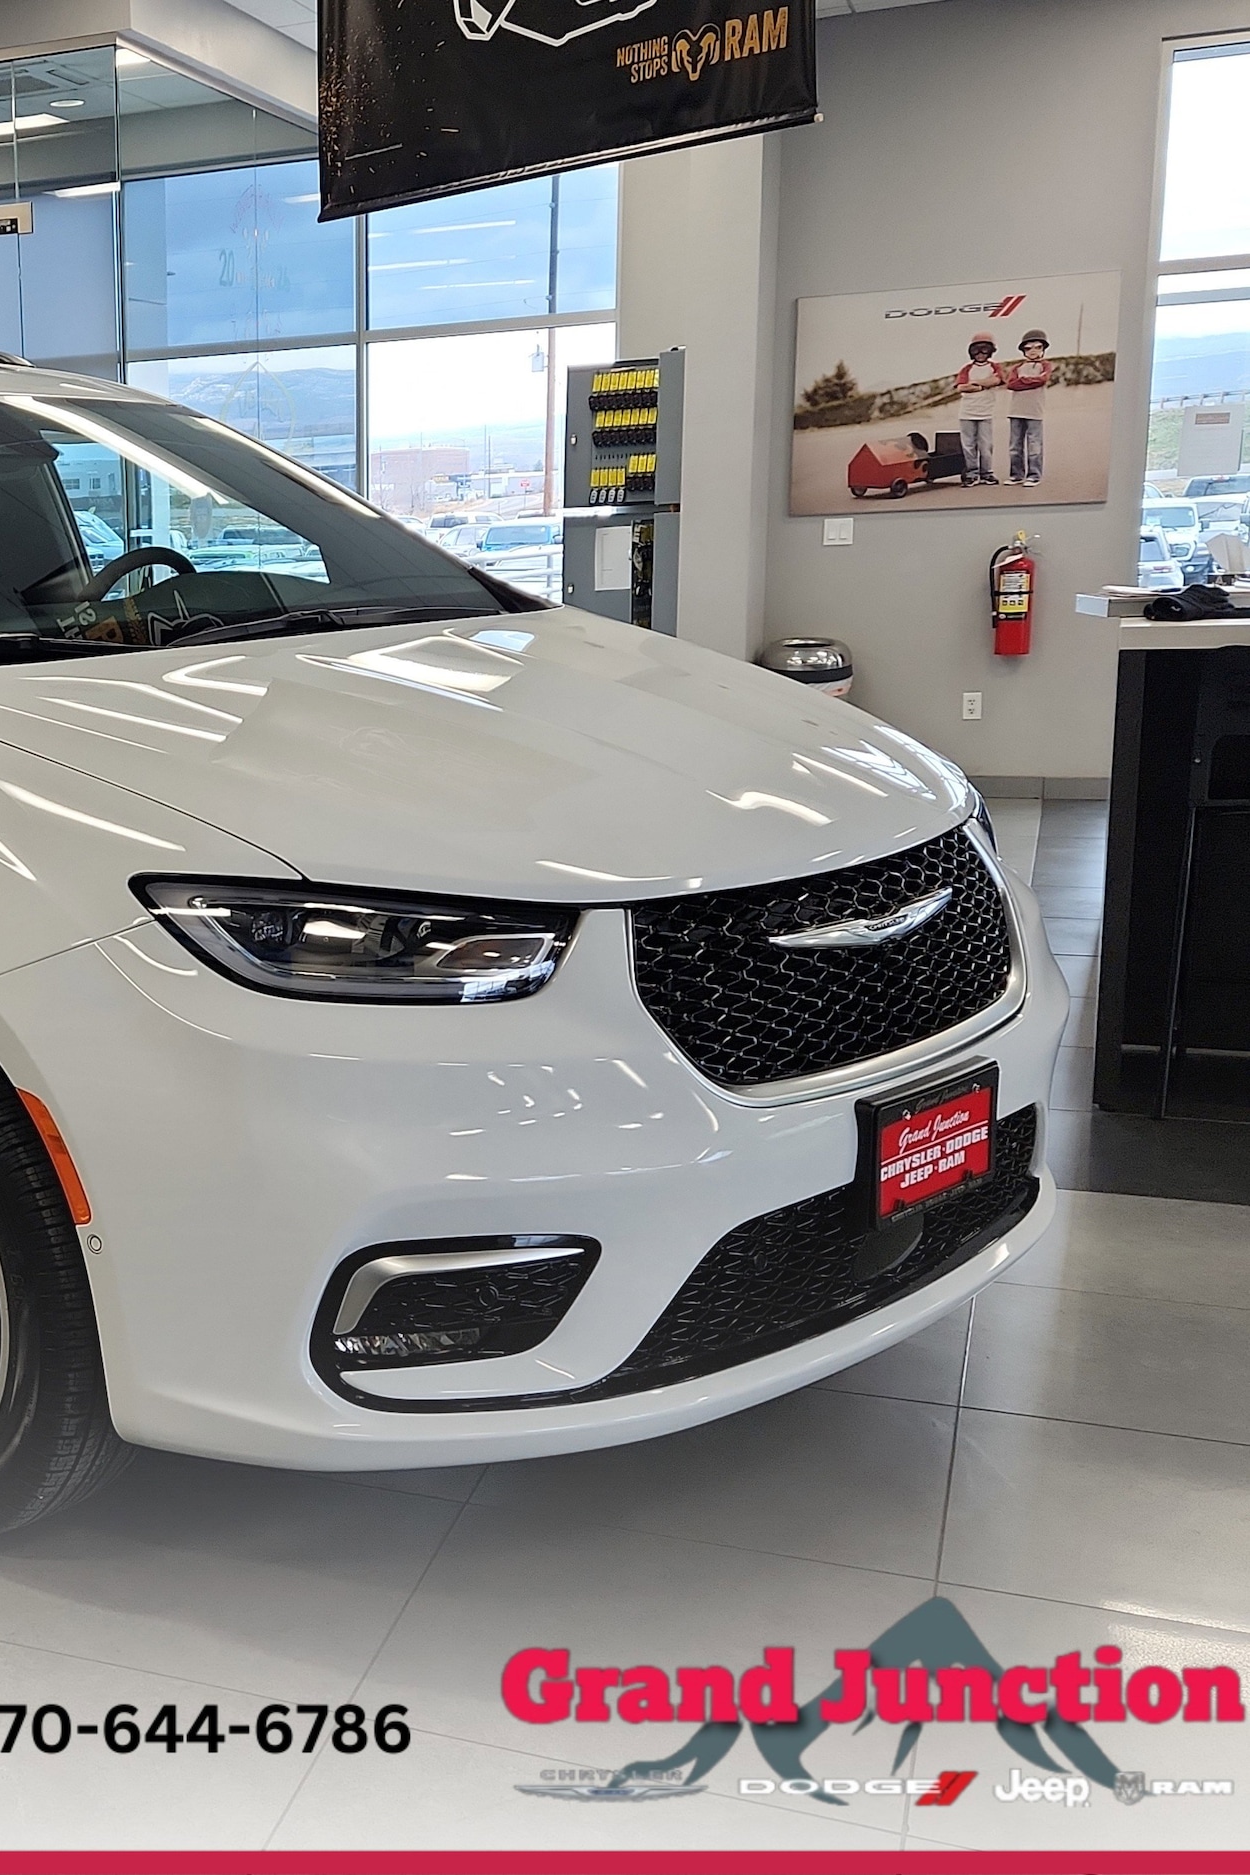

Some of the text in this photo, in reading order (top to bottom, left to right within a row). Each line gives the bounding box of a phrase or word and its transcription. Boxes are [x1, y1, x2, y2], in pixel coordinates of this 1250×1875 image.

[725, 6, 789, 62] RAM
[616, 36, 669, 68] NOTHING
[630, 56, 669, 84] STOPS
[884, 301, 1004, 319] DODGE
[899, 1110, 970, 1154] Grand Junction
